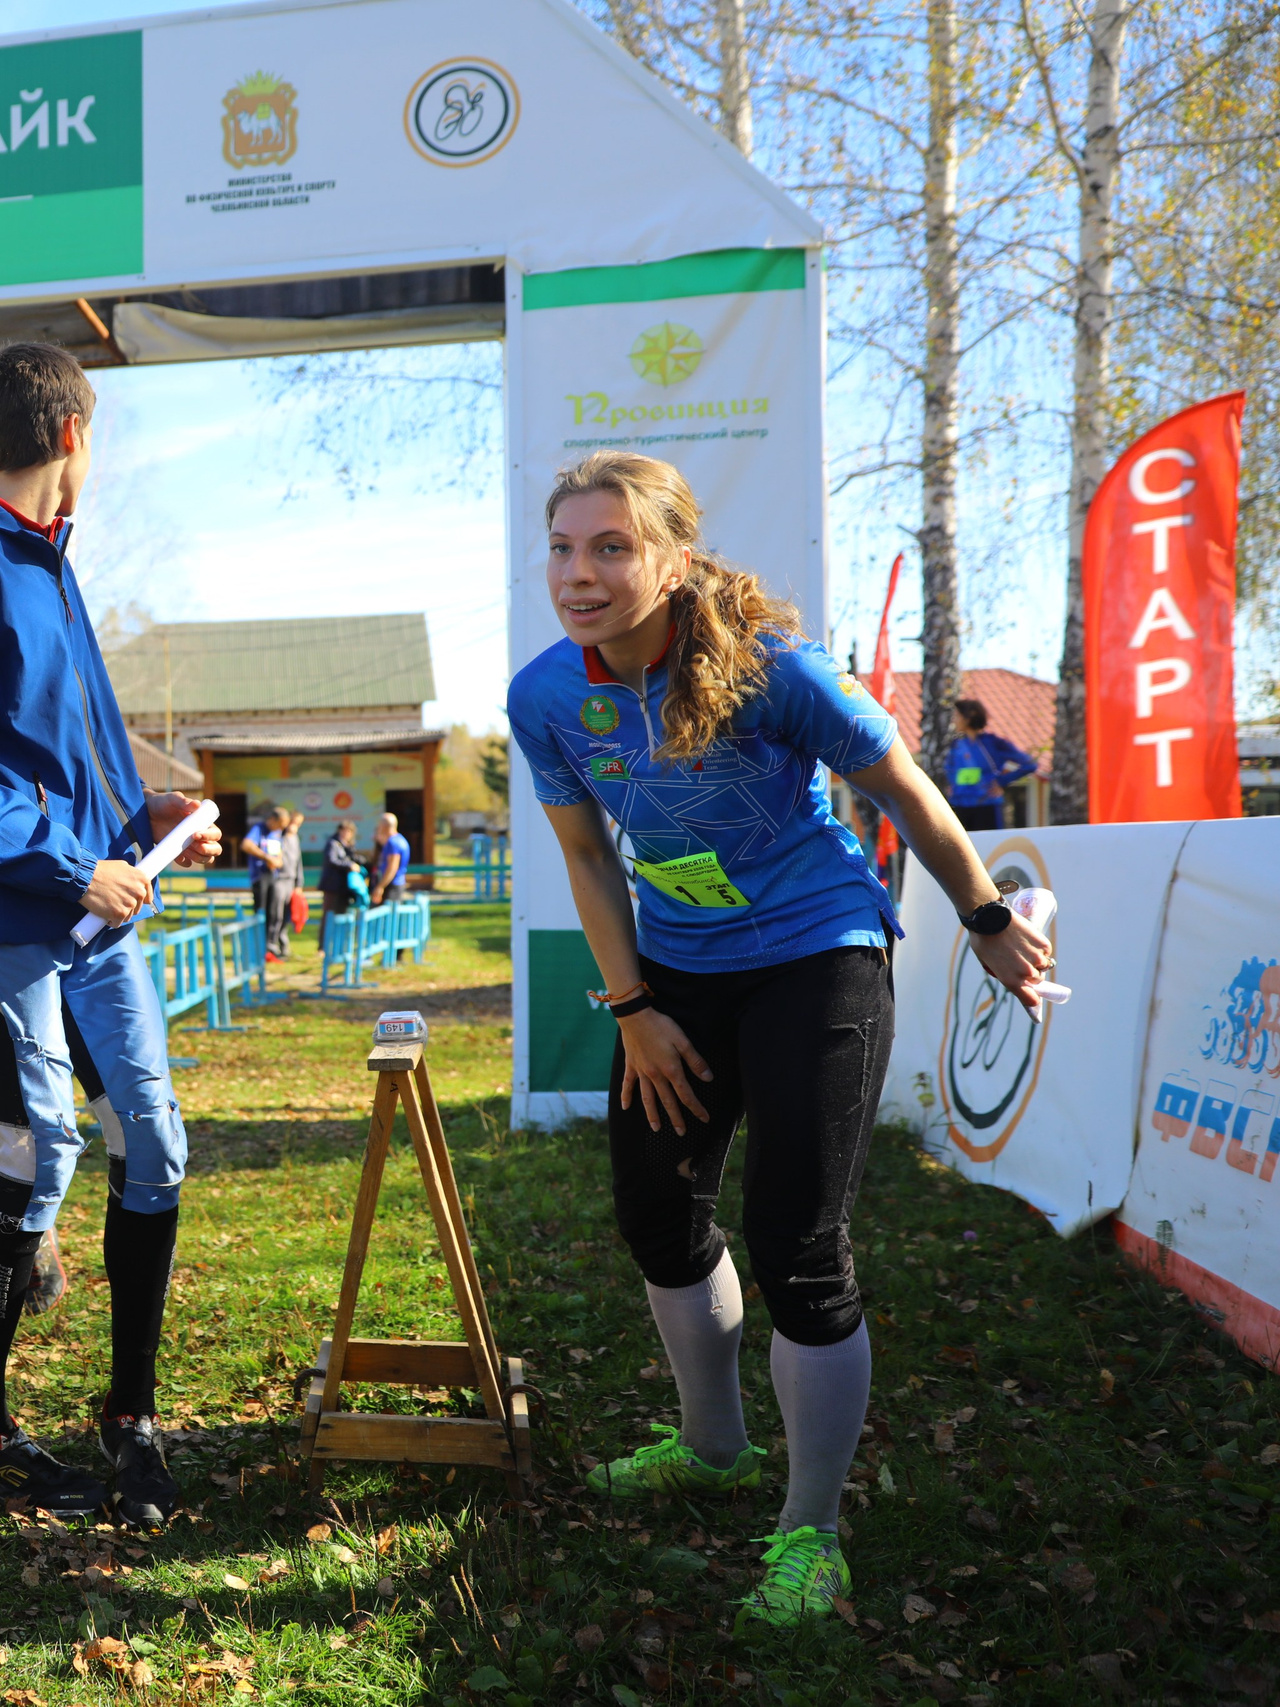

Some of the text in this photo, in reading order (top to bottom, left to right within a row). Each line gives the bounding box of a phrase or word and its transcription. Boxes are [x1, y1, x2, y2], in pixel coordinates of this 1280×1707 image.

[563, 391, 771, 429] Провинция
[731, 427, 769, 440] центр
[1128, 447, 1198, 789] СТАРТ
[598, 761, 622, 773] SFR
[679, 856, 713, 871] ДЕСЯТКА
[705, 882, 731, 891] ЭТАП
[717, 889, 737, 905] 5
[386, 1023, 404, 1033] 149
